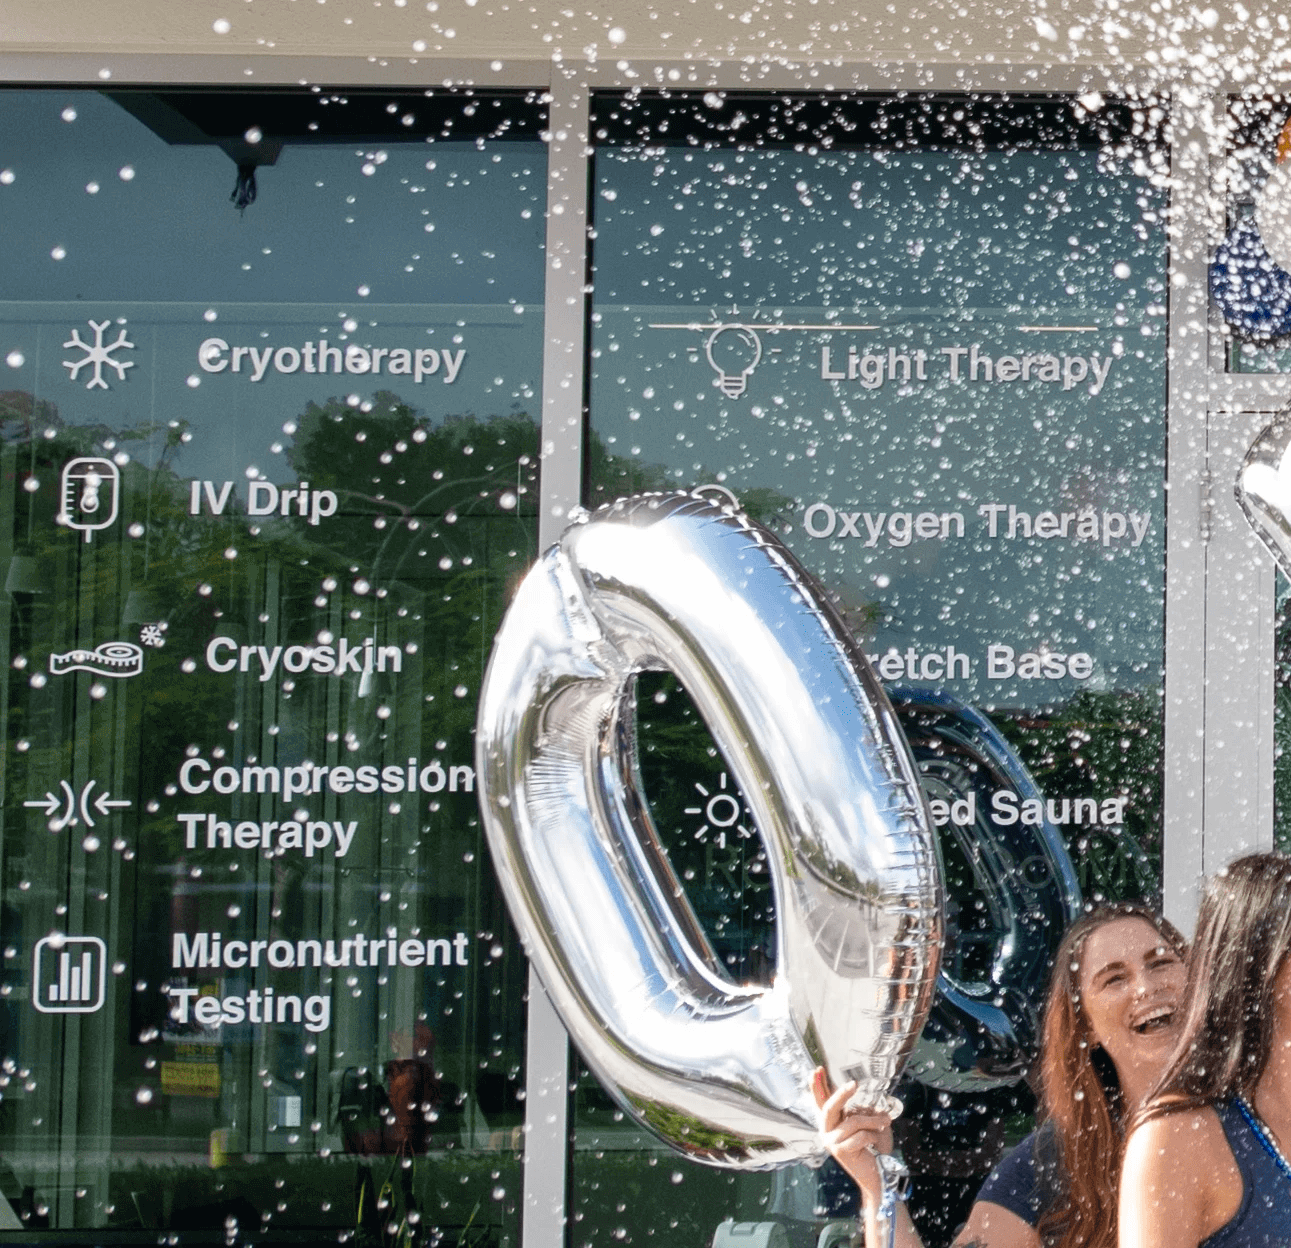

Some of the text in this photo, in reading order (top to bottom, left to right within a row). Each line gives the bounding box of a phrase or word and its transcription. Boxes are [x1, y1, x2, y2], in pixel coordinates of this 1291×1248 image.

[199, 338, 466, 383] Cryotherapy
[821, 346, 1113, 391] Light Therapy
[190, 480, 339, 525] IV Drip
[803, 503, 1152, 547] Oxygen Therapy
[206, 636, 403, 682] Cryoskin
[866, 645, 1094, 680] retch Base
[179, 758, 477, 801] Compression
[990, 789, 1124, 827] Sauna
[177, 813, 358, 856] Therapy
[172, 933, 469, 968] Micronutrient
[169, 987, 331, 1032] Testing
